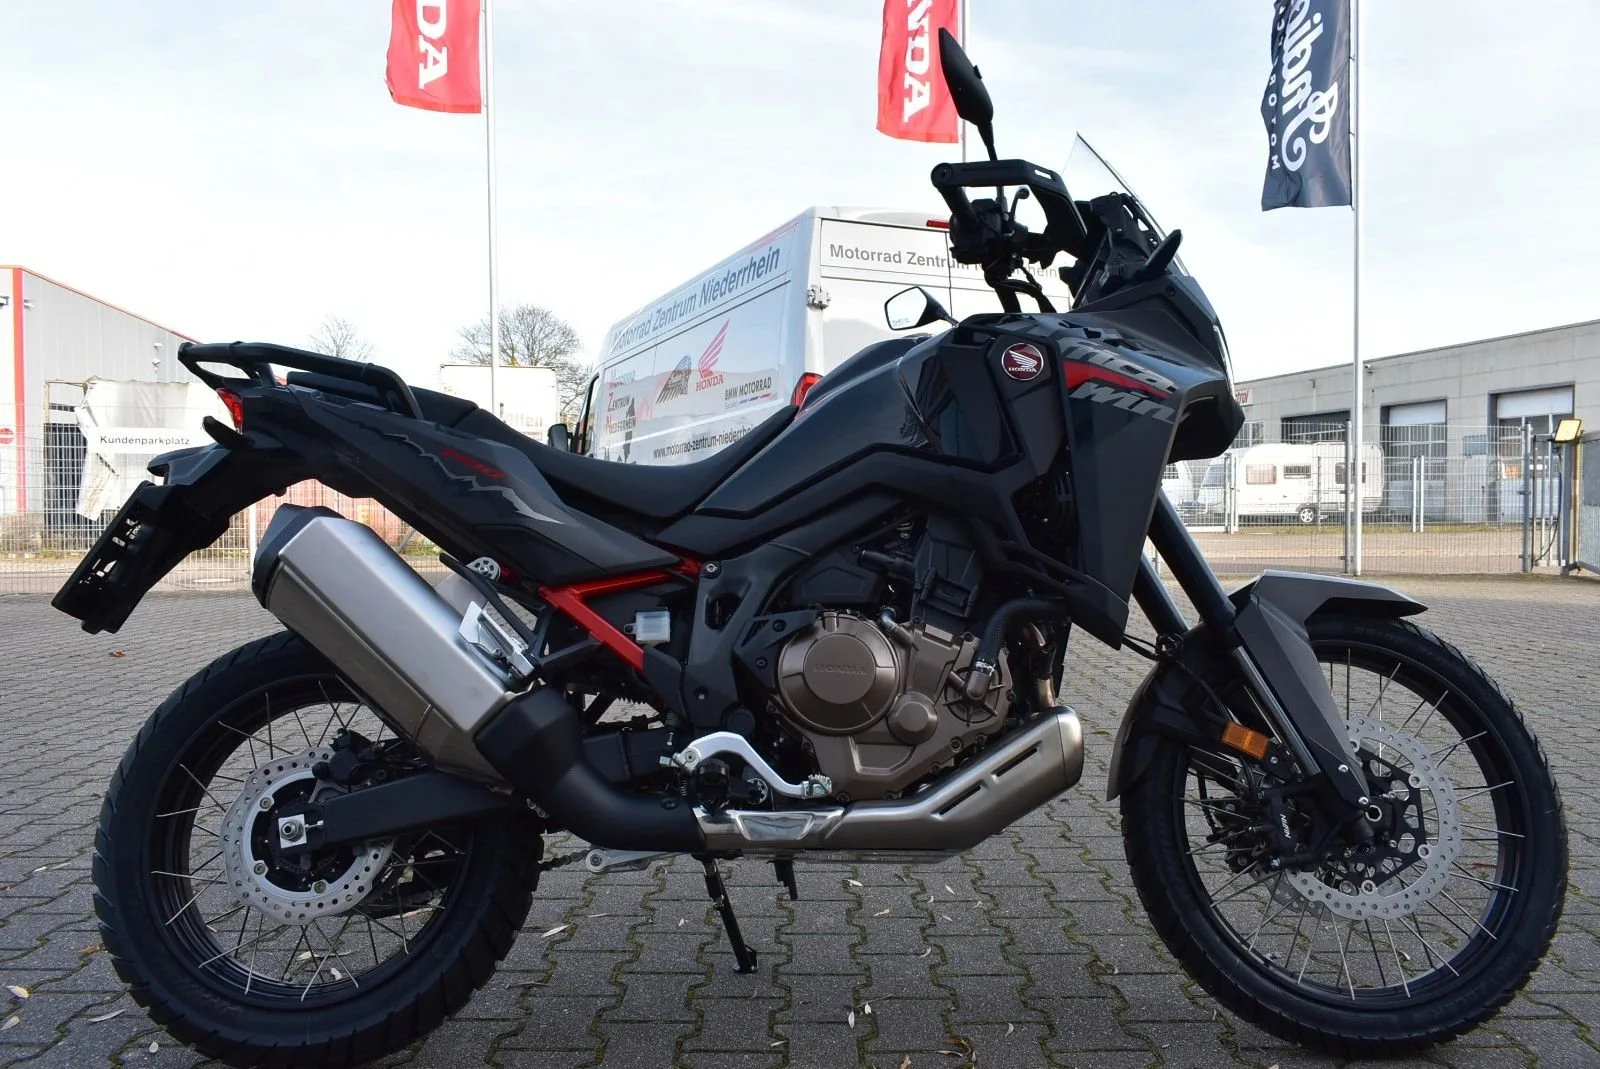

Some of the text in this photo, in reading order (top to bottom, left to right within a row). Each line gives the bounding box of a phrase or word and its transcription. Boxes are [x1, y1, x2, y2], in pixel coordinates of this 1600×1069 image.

[830, 243, 901, 264] Motorrad
[652, 293, 697, 331] Zentrum
[699, 246, 780, 308] Niederrhein
[695, 374, 724, 392] HONDA
[724, 376, 772, 400] BMW MOTORRAD
[100, 435, 190, 446] Kundenparkplatz
[812, 663, 868, 675] HONDA
